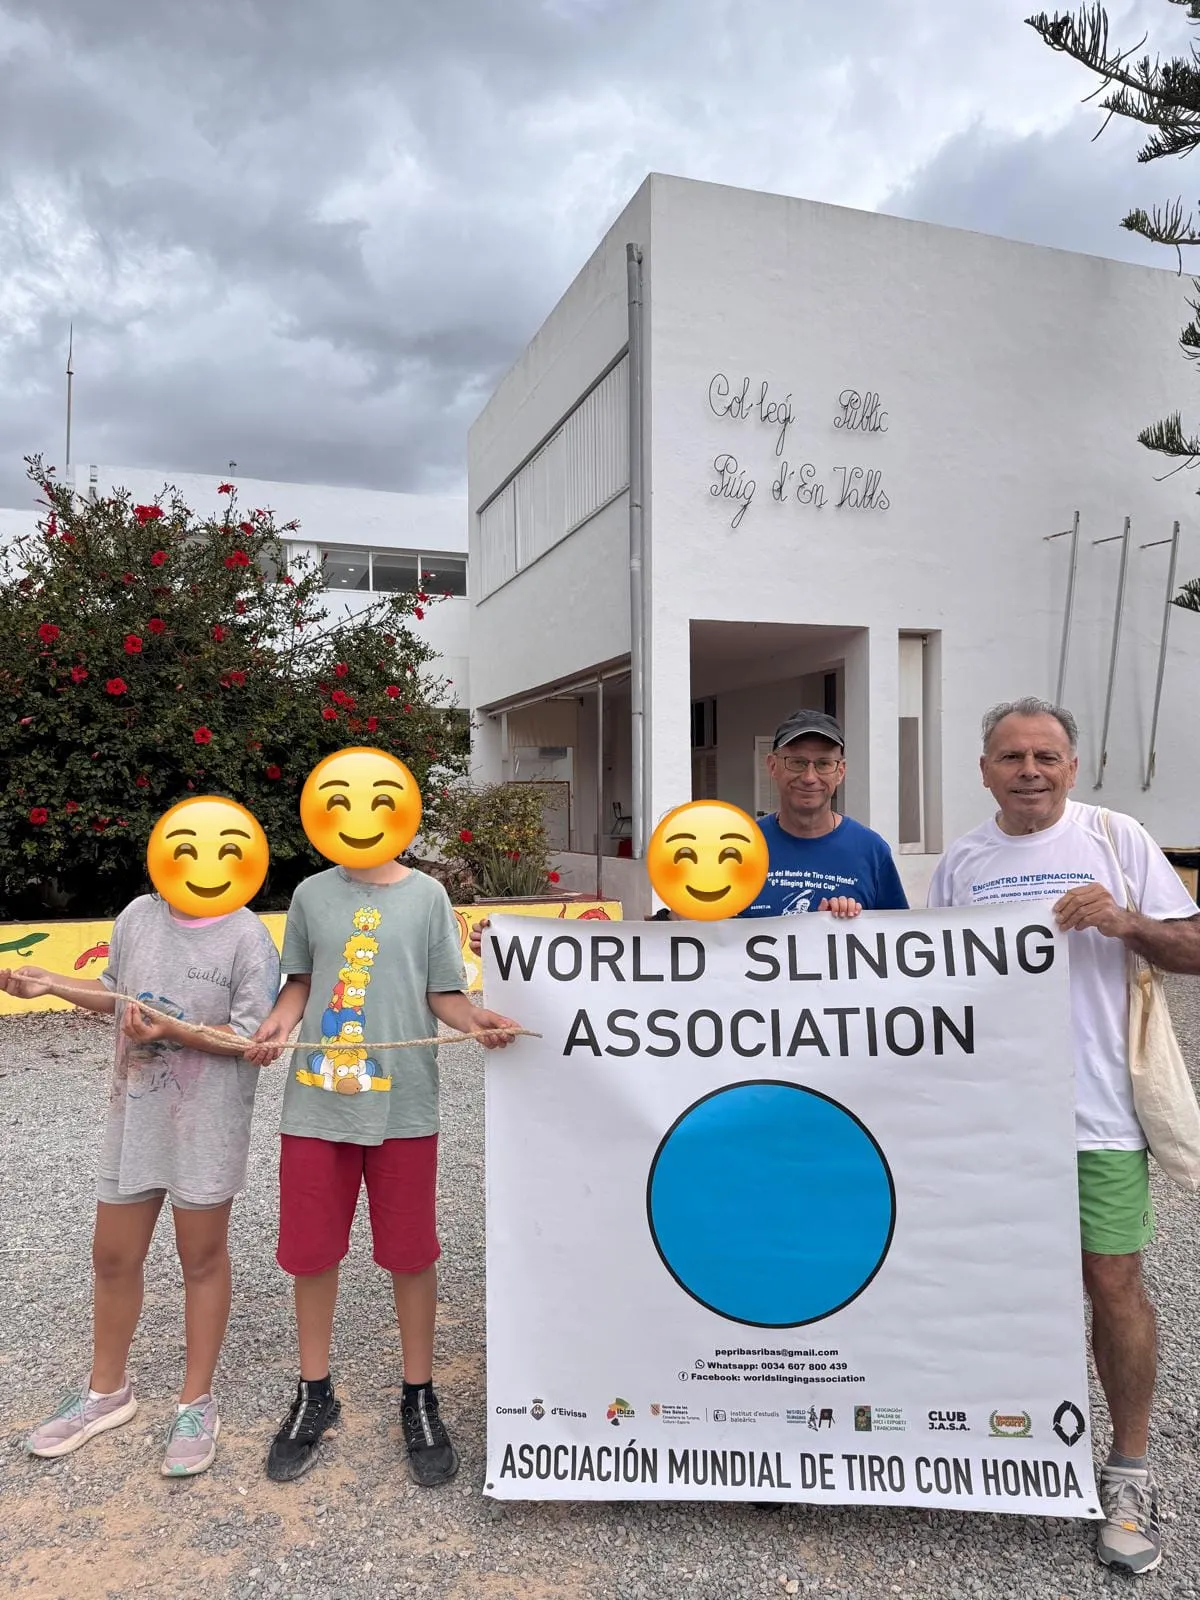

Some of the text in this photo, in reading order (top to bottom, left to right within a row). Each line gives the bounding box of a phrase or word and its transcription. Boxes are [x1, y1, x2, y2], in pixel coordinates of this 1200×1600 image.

[832, 466, 890, 510] Valls
[812, 872, 824, 880] Tiro
[972, 876, 1018, 892] ENCUENTRO
[1020, 872, 1096, 882] INTERNACIONAL
[780, 878, 804, 888] Slinging
[804, 880, 822, 889] World
[490, 924, 1056, 982] WORLD SLINGING
[562, 1005, 975, 1058] ASSOCIATION
[715, 1348, 838, 1358] pepribasribas@gmail.com
[707, 1362, 758, 1372] Whatsapp:
[788, 1362, 806, 1370] 607
[691, 1373, 866, 1384] Facebook: worldslingingassociation
[496, 1406, 587, 1418] Consell d'Eivissa
[928, 1410, 967, 1422] CLUB
[928, 1422, 971, 1432] J.A.S.A.
[500, 1438, 1084, 1499] ASOCIACIÓN MUNDIAL DE TIRO CON HONDA
